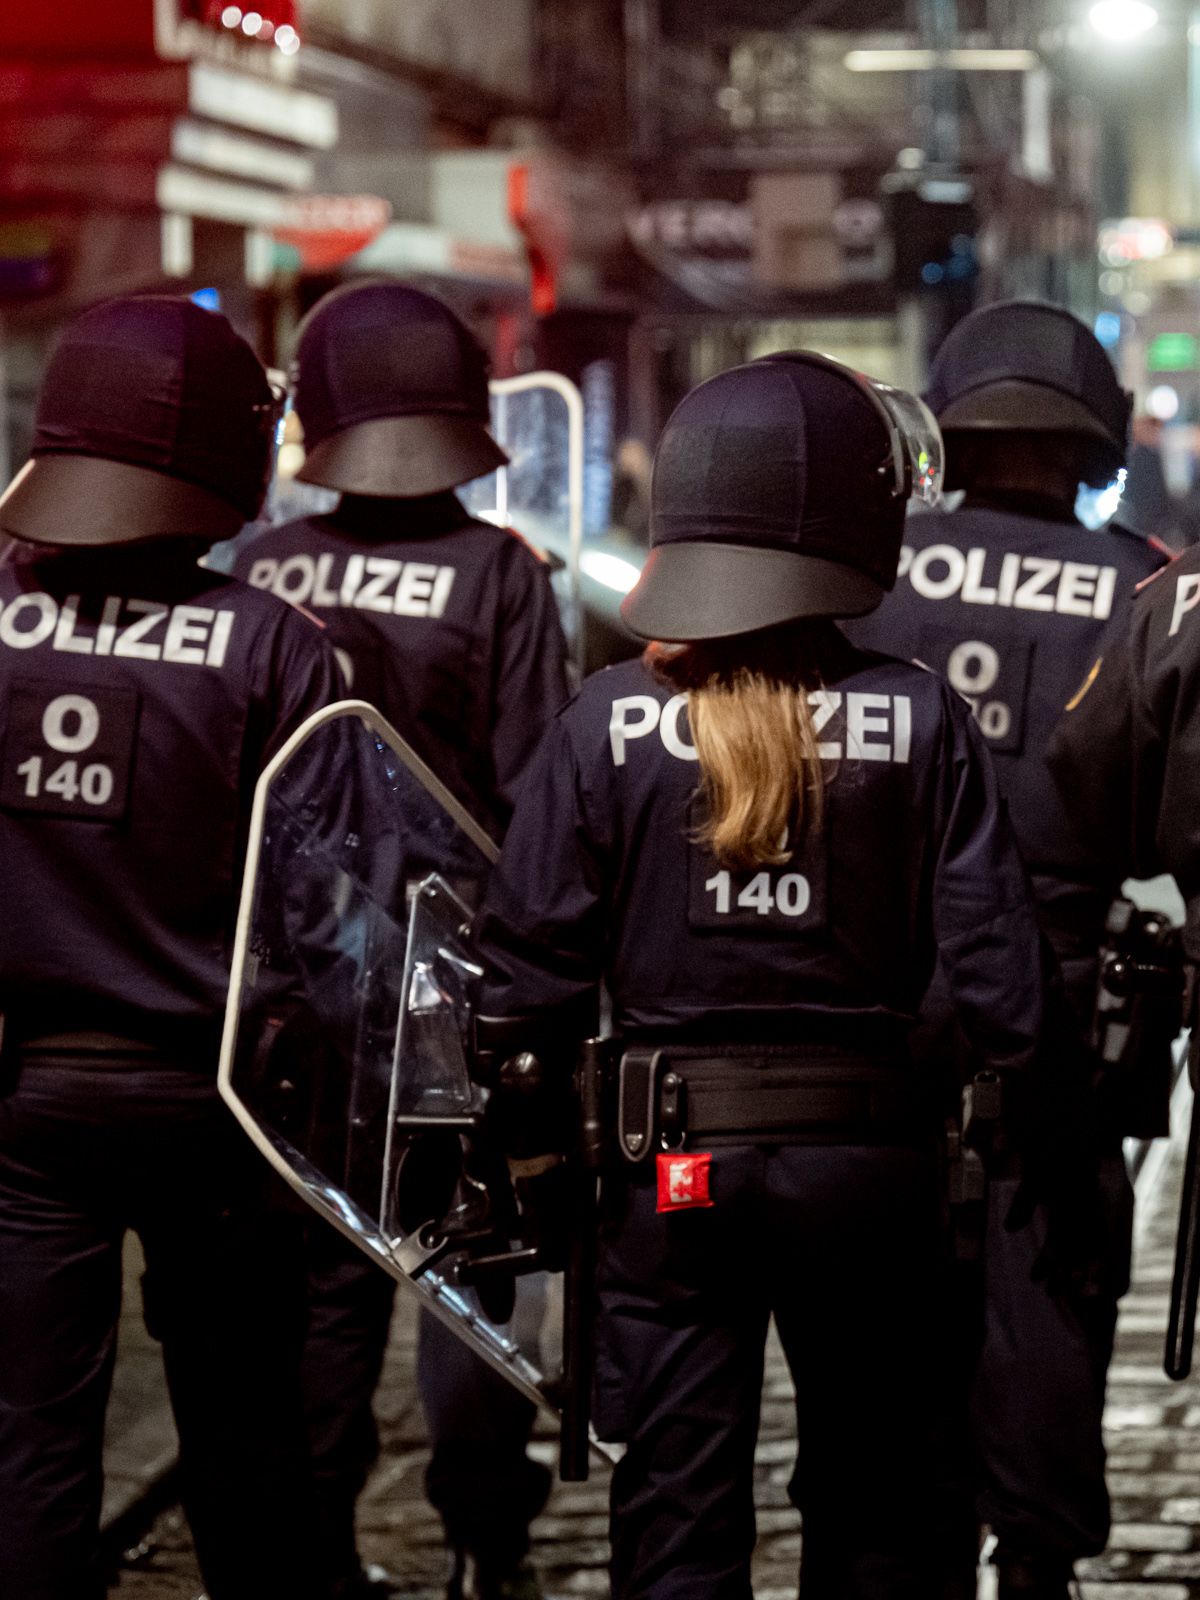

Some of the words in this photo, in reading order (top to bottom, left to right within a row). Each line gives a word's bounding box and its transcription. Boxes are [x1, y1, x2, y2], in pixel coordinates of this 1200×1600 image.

[0, 591, 236, 668] OLIZEI
[609, 690, 912, 767] POZEI
[17, 755, 114, 805] 140
[705, 870, 811, 917] 140
